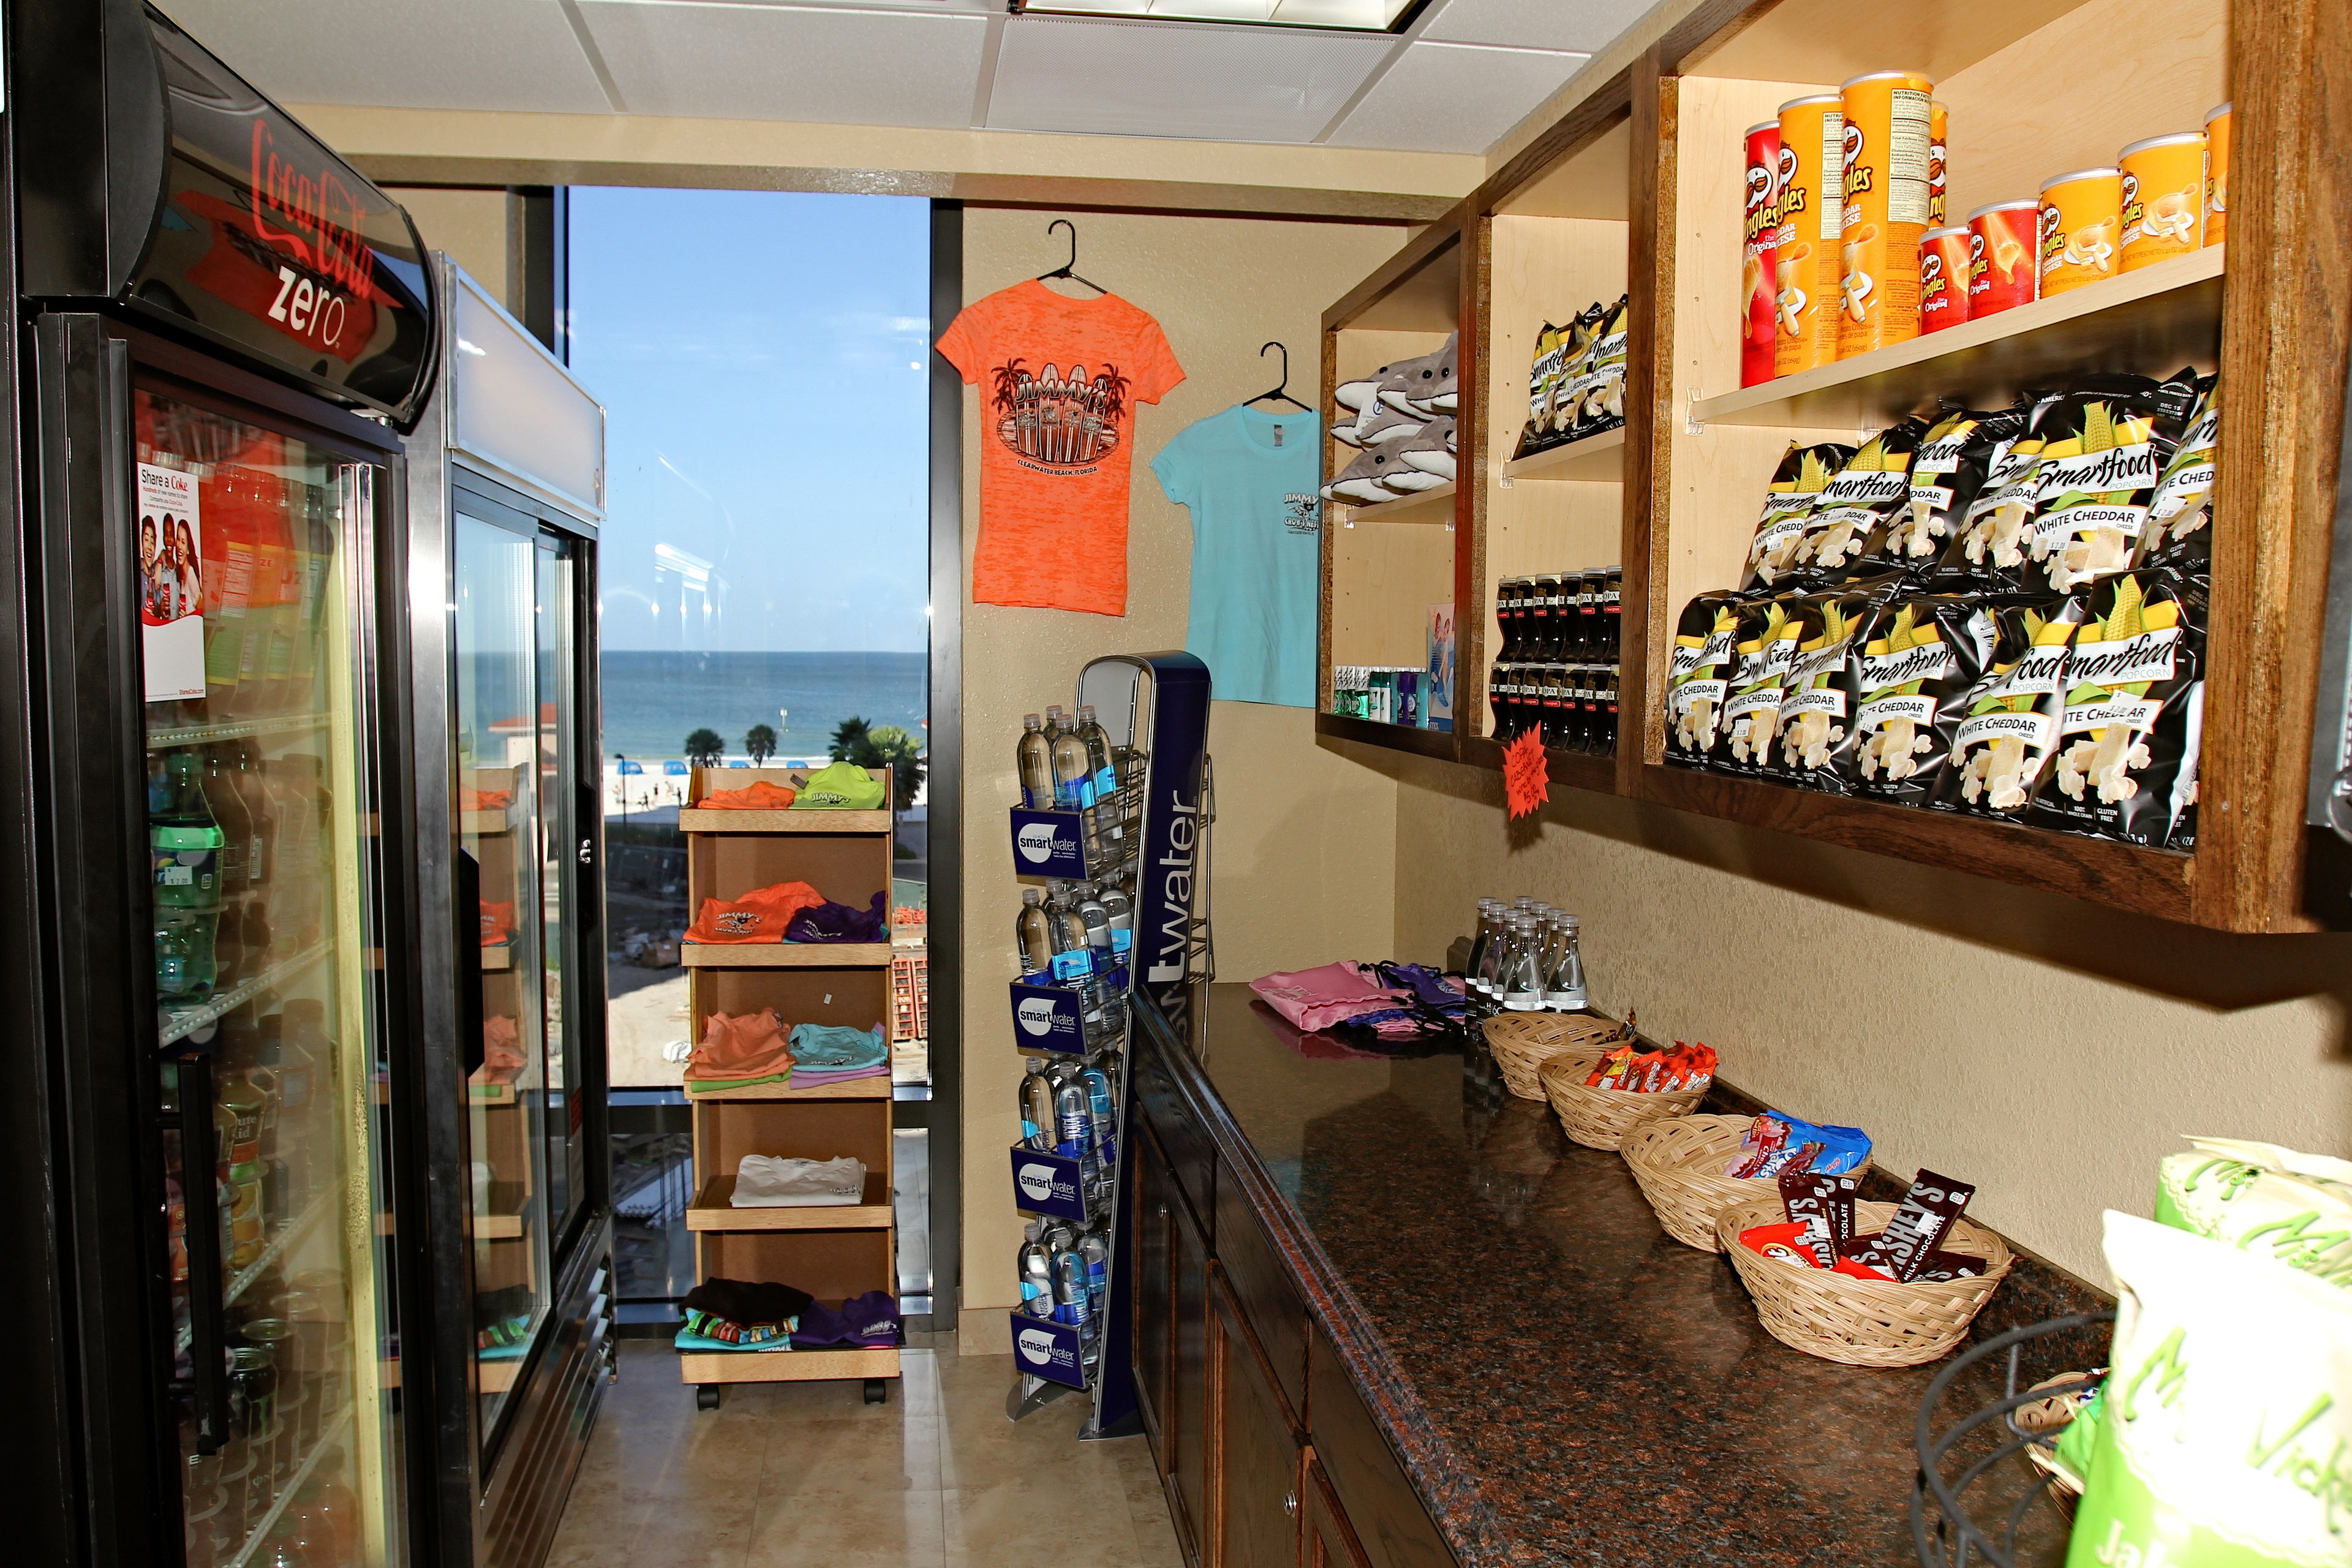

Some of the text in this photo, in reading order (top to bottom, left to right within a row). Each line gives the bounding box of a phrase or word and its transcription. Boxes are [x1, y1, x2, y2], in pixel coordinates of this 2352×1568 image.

[1844, 166, 1872, 205] gles
[1777, 188, 1806, 223] gles
[1842, 204, 1861, 218] DDAR
[1744, 203, 1777, 242] ingles
[1777, 223, 1796, 236] DDAR
[1747, 241, 1776, 255] Origina
[1923, 277, 1945, 302] ingles
[1970, 281, 1990, 295] Original
[268, 265, 345, 347] zero
[1925, 298, 1948, 312] Original
[1014, 379, 1107, 409] JIMMY'S
[2041, 394, 2065, 403] AMERIC
[1017, 459, 1054, 475] CLEARWATER
[1075, 466, 1098, 475] FLORIDA
[2036, 444, 2155, 494] Smartfood
[141, 469, 188, 491] Share a Coke
[2109, 478, 2154, 489] POPCORN
[2179, 471, 2214, 485] CHED
[1823, 472, 1908, 501] martfood
[1283, 492, 1319, 504] JIMMY
[1910, 490, 1940, 500] DDAR
[1845, 511, 1868, 521] DDAR
[2034, 510, 2135, 535] WHITE CHEDDAR
[1755, 523, 1803, 546] WHITE CHEDD
[2170, 543, 2186, 552] GLUTEN
[2071, 628, 2183, 677] martfood
[1861, 642, 1956, 682] Smartfood
[2120, 668, 2171, 680] POPCORN
[1683, 685, 1719, 695] CHEDDAR
[2013, 682, 2054, 693] POPCORN
[1728, 693, 1780, 712] WHITE CHEDDA
[1781, 696, 1834, 715] WHITE CHEDDAR
[1878, 703, 1924, 712] CHEDDAR
[1958, 717, 2037, 739] WHITE CHEDDAR
[811, 792, 851, 804] JIMMY'S
[2097, 808, 2117, 816] GLUTEN
[1020, 836, 1077, 851] smartwater
[1148, 790, 1198, 982] twater
[1020, 1010, 1076, 1027] smartwater
[1020, 1175, 1076, 1195] smartwater
[1950, 1192, 1959, 1202] 210
[1904, 1215, 1946, 1281] MILK CHOCOLATE
[1020, 1339, 1075, 1362] smartwater
